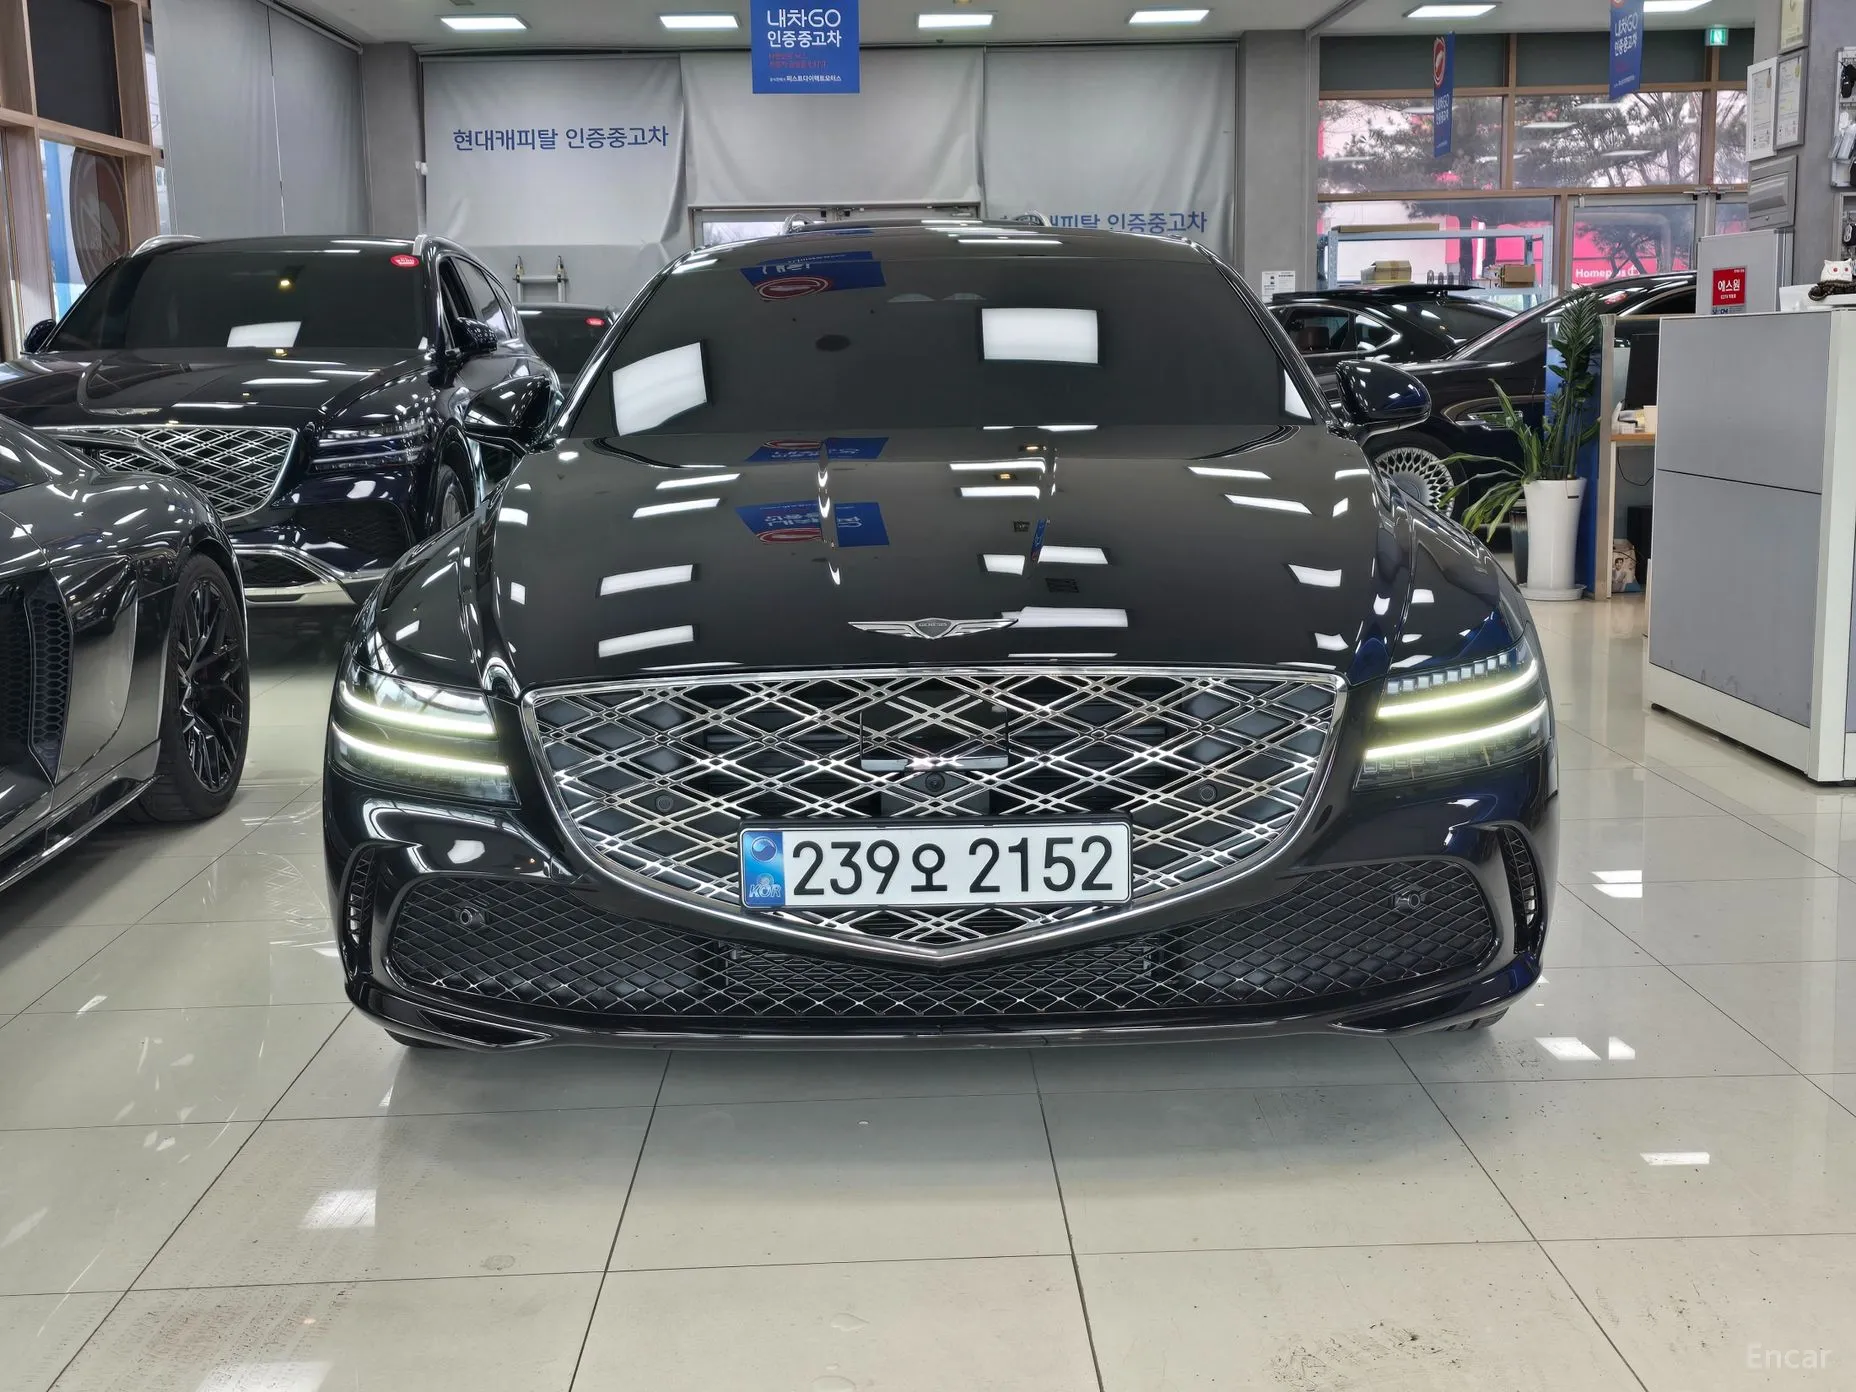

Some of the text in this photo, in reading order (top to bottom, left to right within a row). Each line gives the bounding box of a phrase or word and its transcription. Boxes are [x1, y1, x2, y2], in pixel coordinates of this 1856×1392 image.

[767, 8, 842, 28] 내차GO
[767, 29, 842, 48] 인증중고차
[452, 125, 669, 151] 현대캐피탈 인증중고차
[1575, 268, 1627, 280] Homepus
[1717, 278, 1741, 292] 에스원
[792, 835, 1114, 896] 239오 2152
[749, 883, 781, 898] KOR
